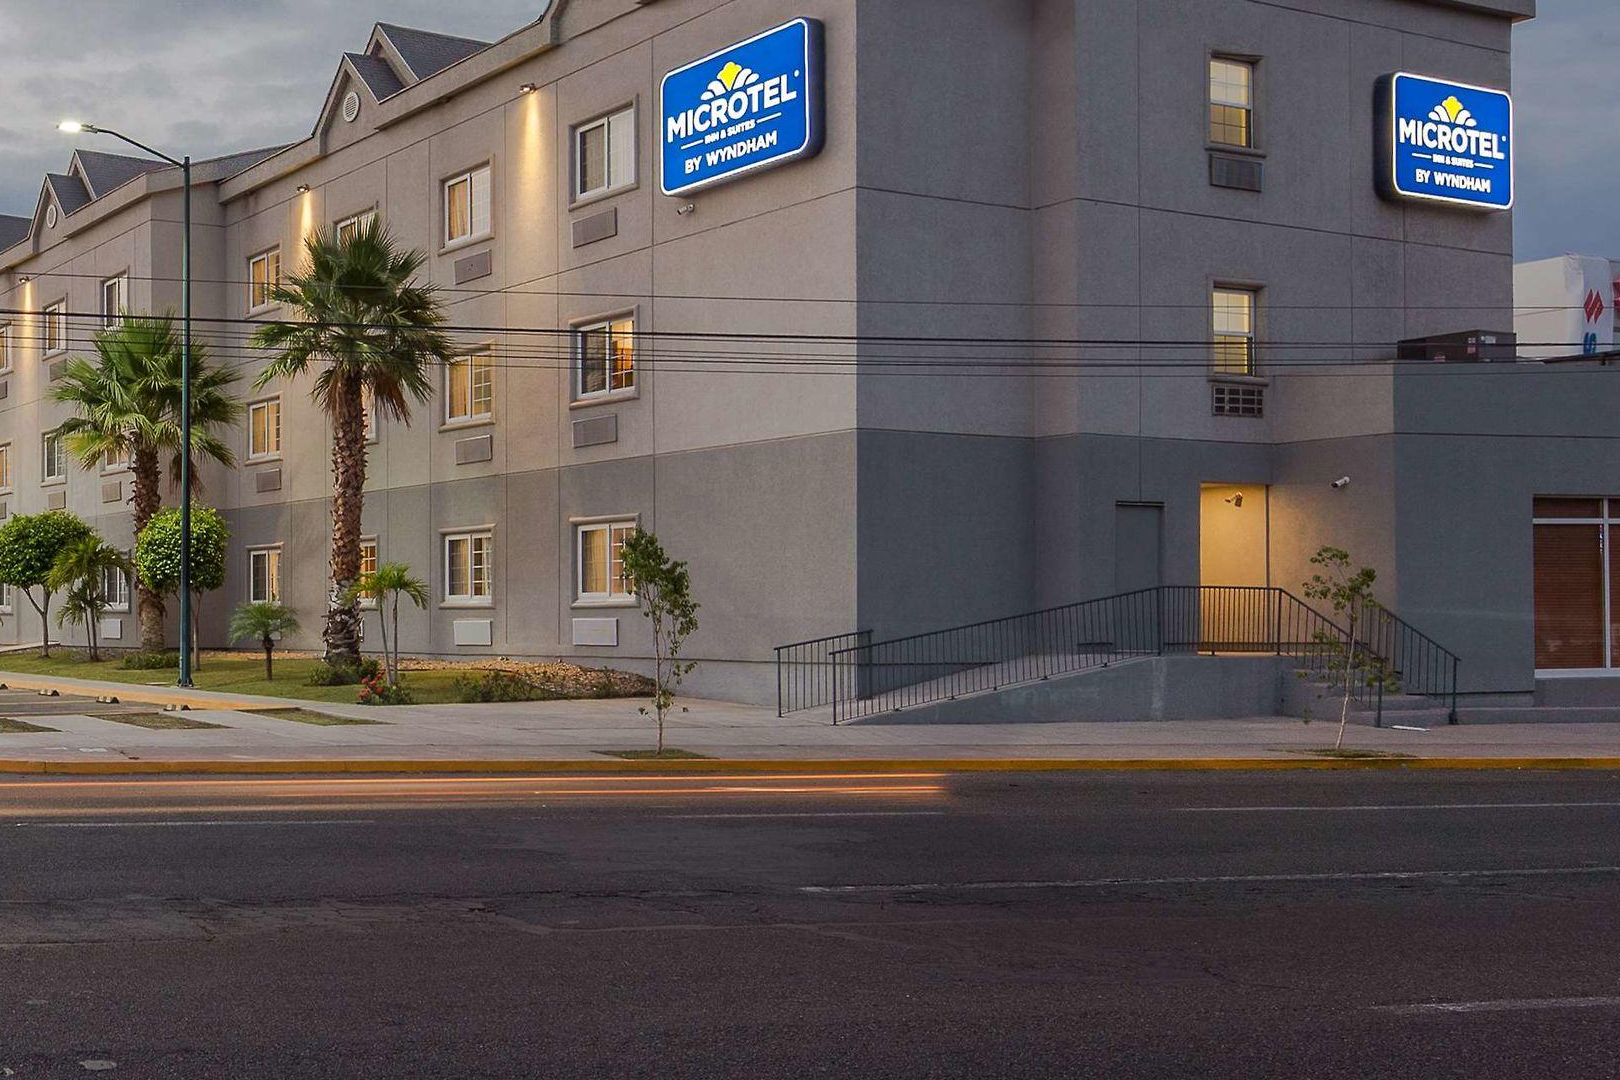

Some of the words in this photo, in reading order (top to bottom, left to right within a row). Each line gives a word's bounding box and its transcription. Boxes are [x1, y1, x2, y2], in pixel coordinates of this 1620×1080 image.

[667, 74, 797, 143] MICROTEL
[685, 155, 702, 174] BY
[706, 130, 778, 167] WYNDHAM
[1399, 117, 1505, 160] MICROTEL
[1415, 168, 1430, 184] BY
[1434, 171, 1491, 193] WYNDHAM
